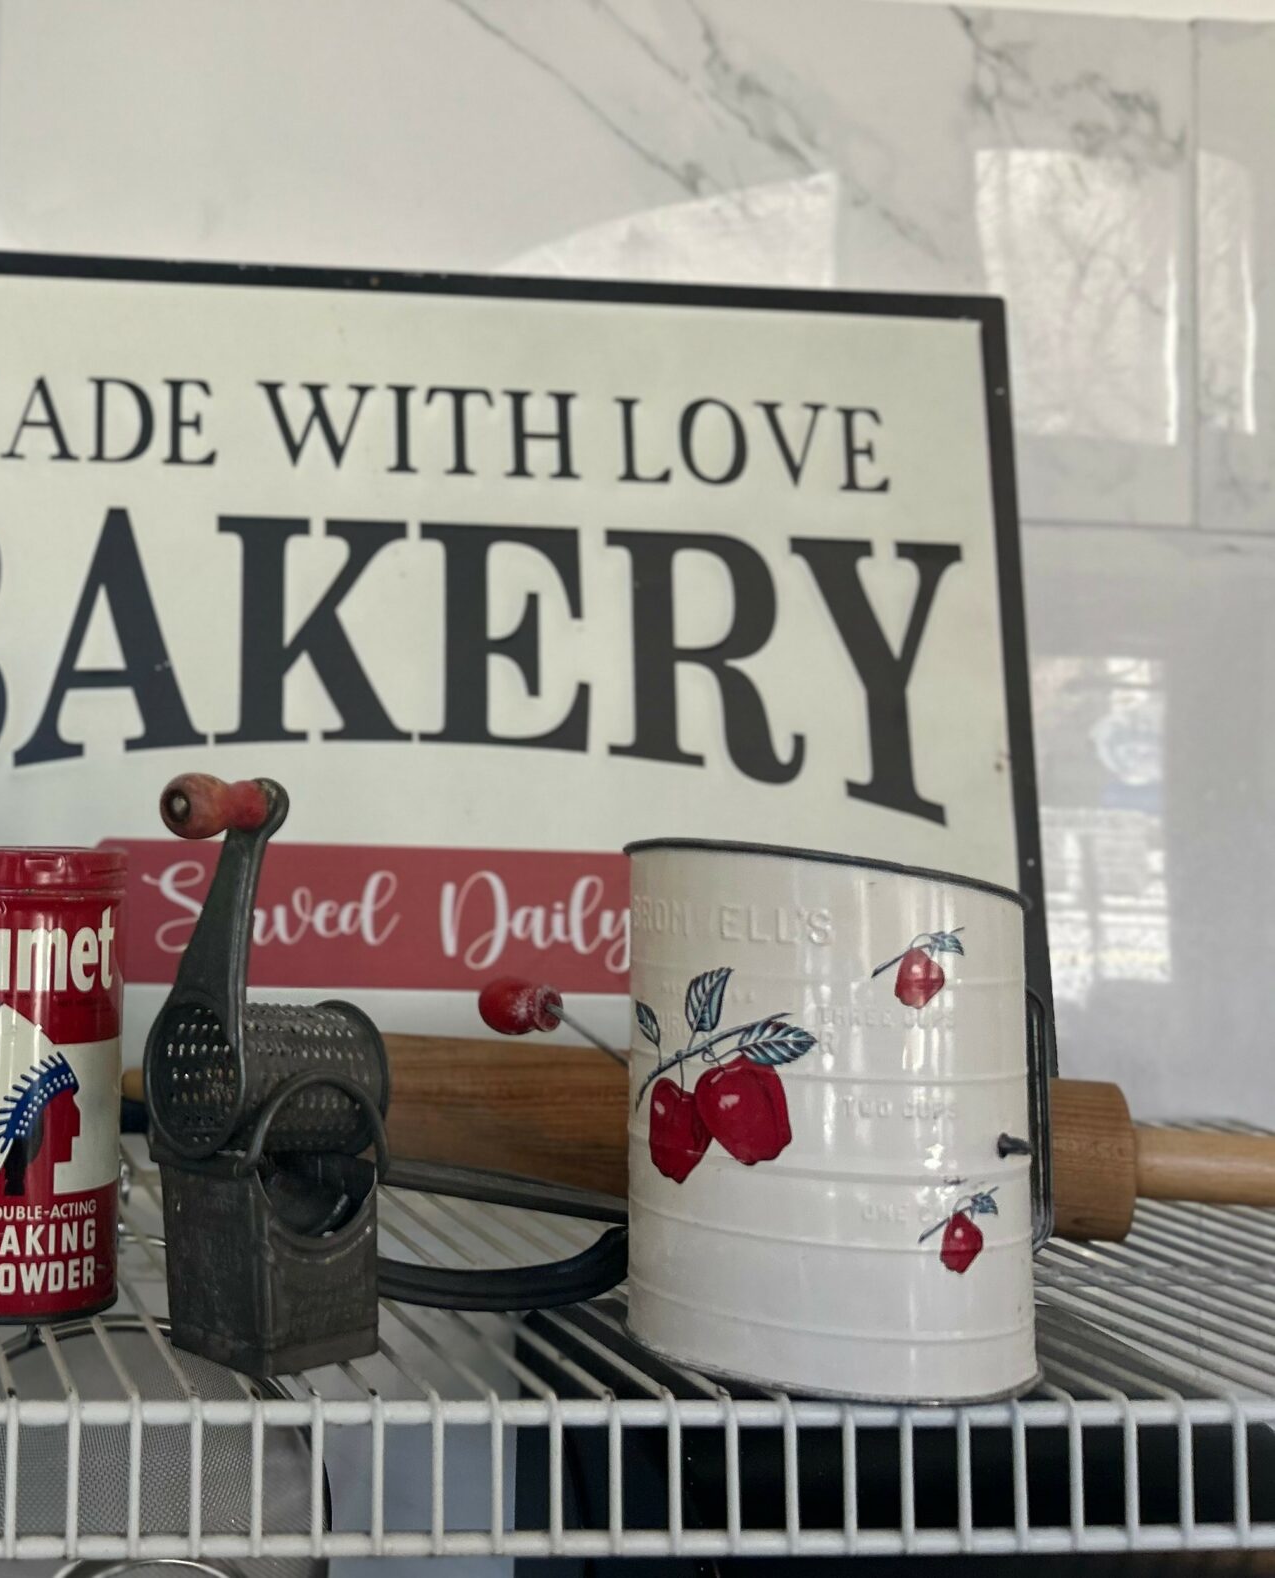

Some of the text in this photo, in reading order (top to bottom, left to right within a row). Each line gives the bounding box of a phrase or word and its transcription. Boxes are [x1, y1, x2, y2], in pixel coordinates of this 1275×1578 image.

[256, 380, 582, 481] WITH
[615, 396, 891, 495] LOVE
[142, 860, 632, 974] Srved Daily
